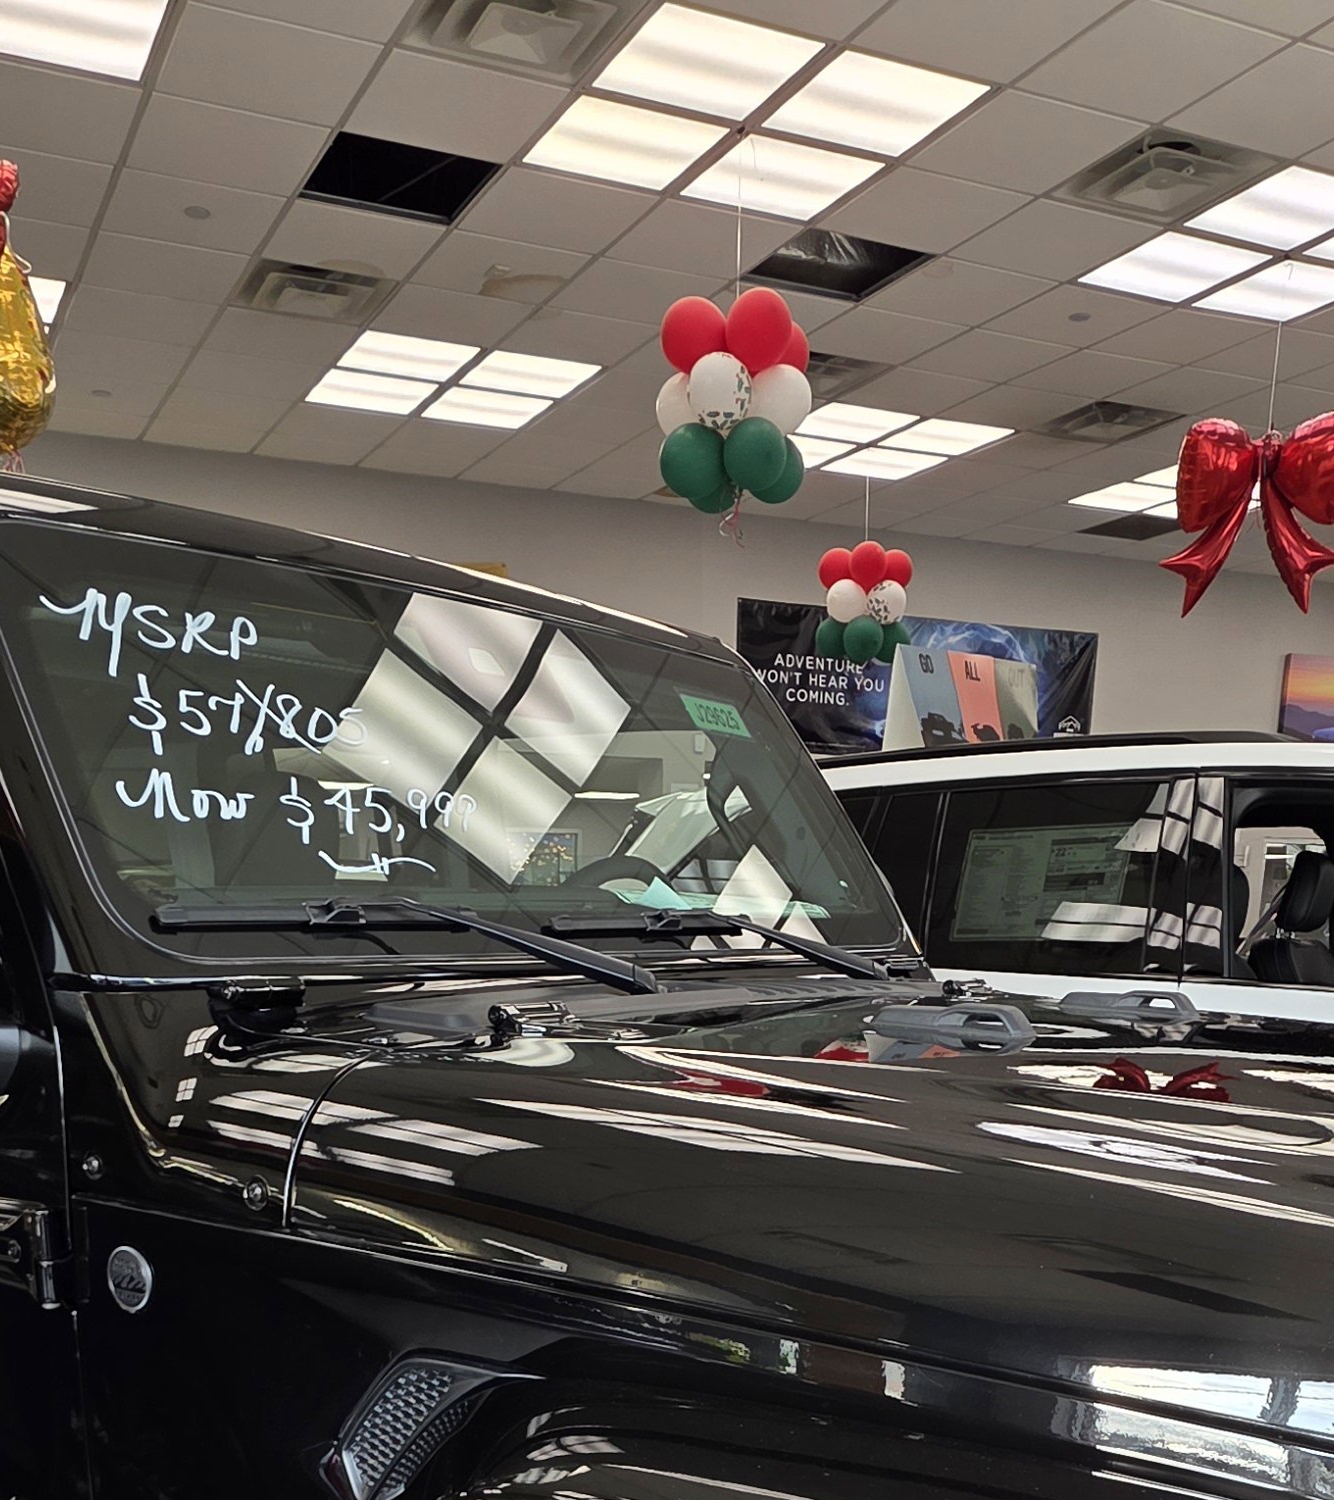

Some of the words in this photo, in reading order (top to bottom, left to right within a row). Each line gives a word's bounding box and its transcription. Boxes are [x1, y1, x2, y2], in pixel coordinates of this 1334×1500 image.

[39, 587, 259, 678] MSRP
[774, 653, 864, 675] ADVENTURE
[918, 652, 935, 674] GO
[964, 659, 982, 682] ALL
[809, 673, 848, 689] HEAR
[854, 677, 885, 692] YOU
[786, 688, 849, 706] COMING.
